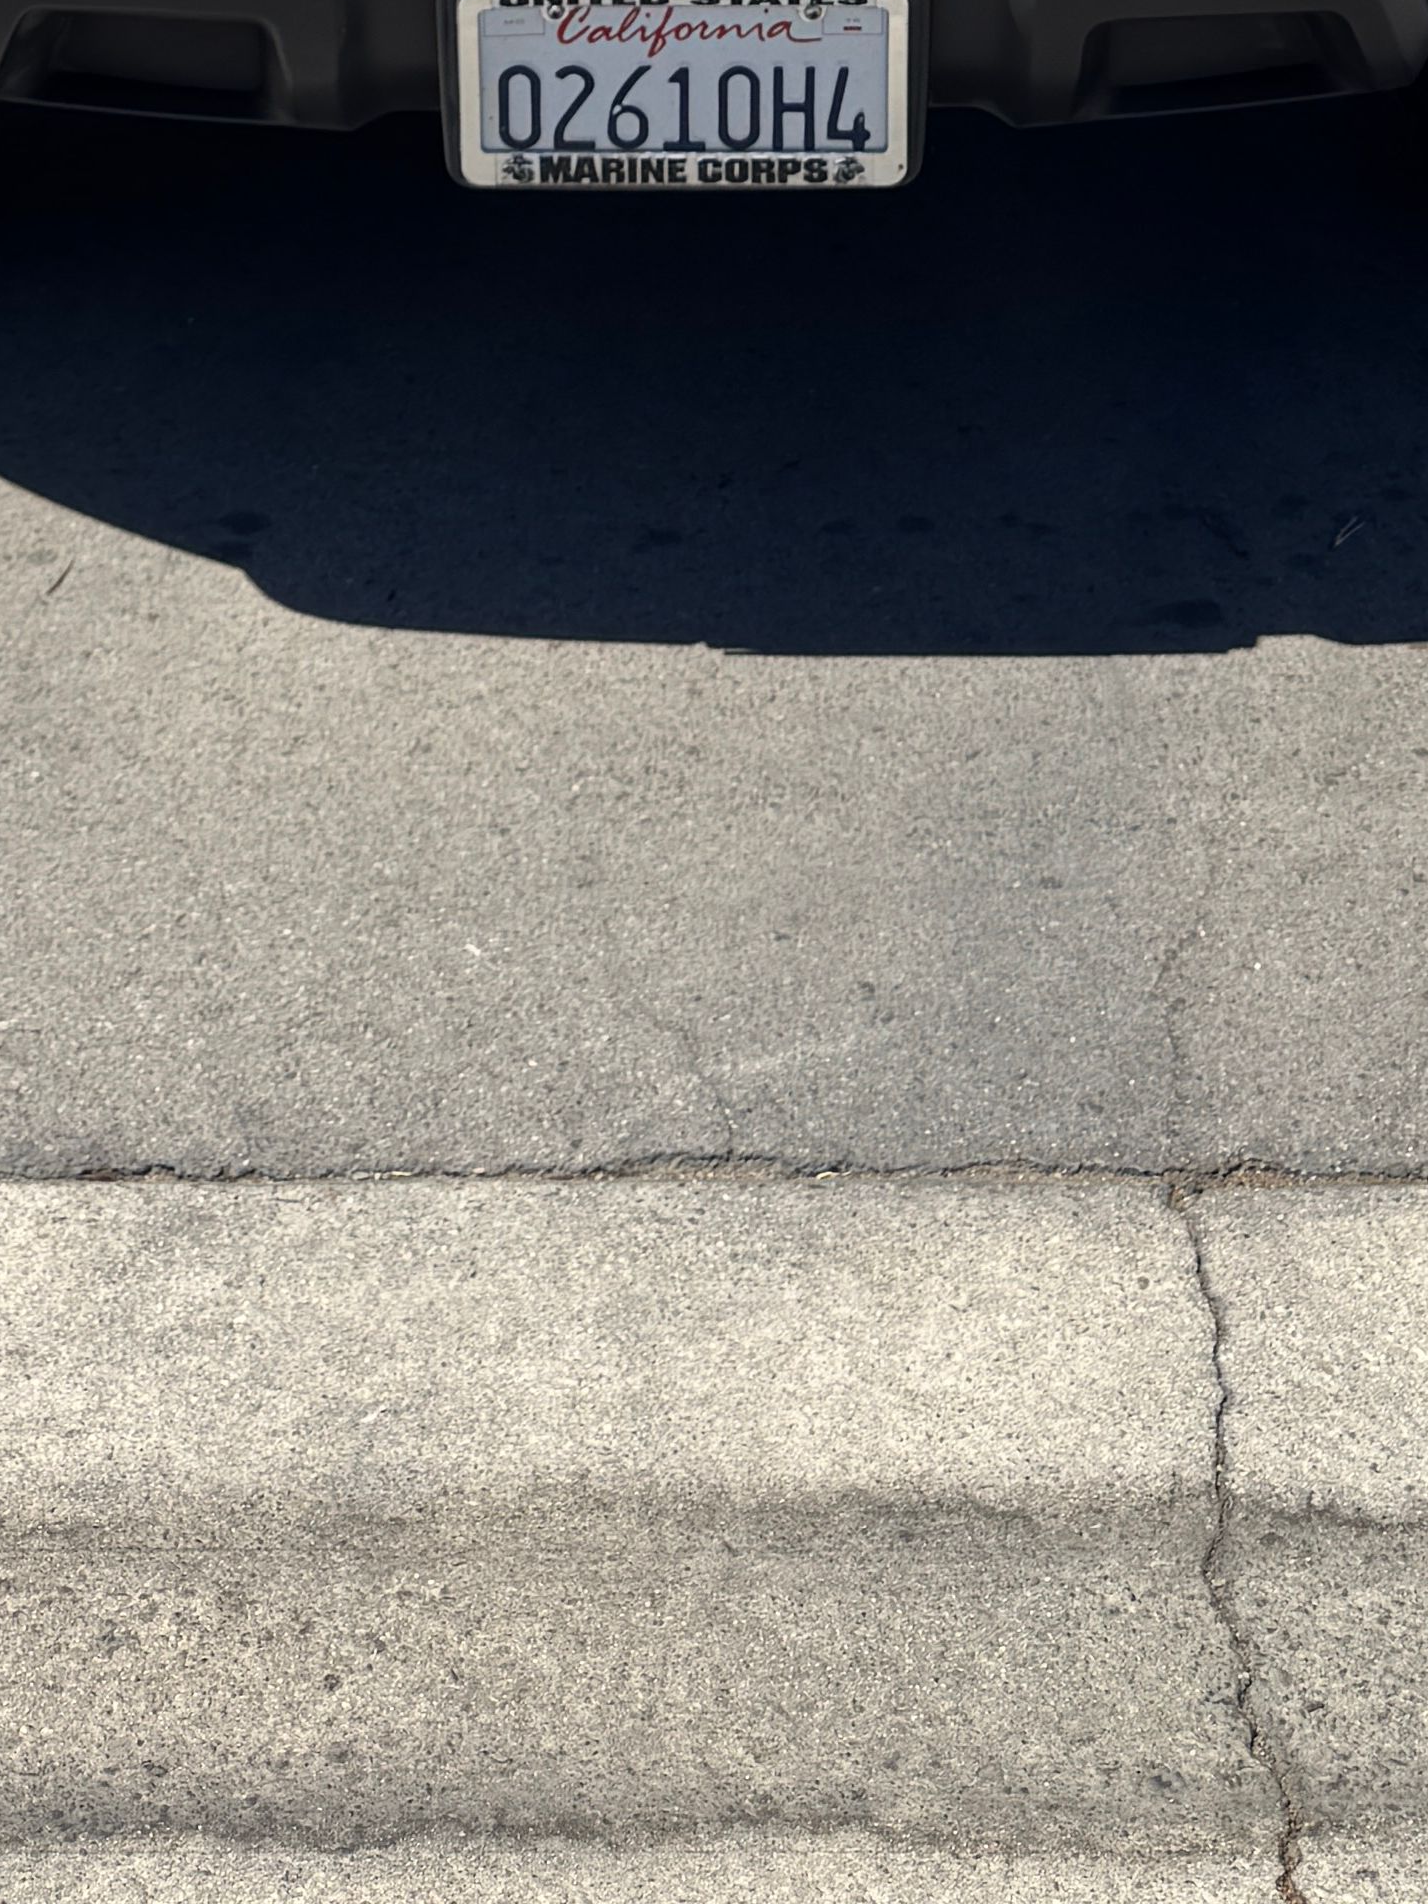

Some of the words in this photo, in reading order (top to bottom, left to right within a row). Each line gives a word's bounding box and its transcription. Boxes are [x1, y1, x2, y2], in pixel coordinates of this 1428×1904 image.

[557, 5, 822, 59] California
[497, 64, 872, 152] 02610H4
[539, 156, 689, 185] MARINE
[697, 156, 829, 185] CORPS
